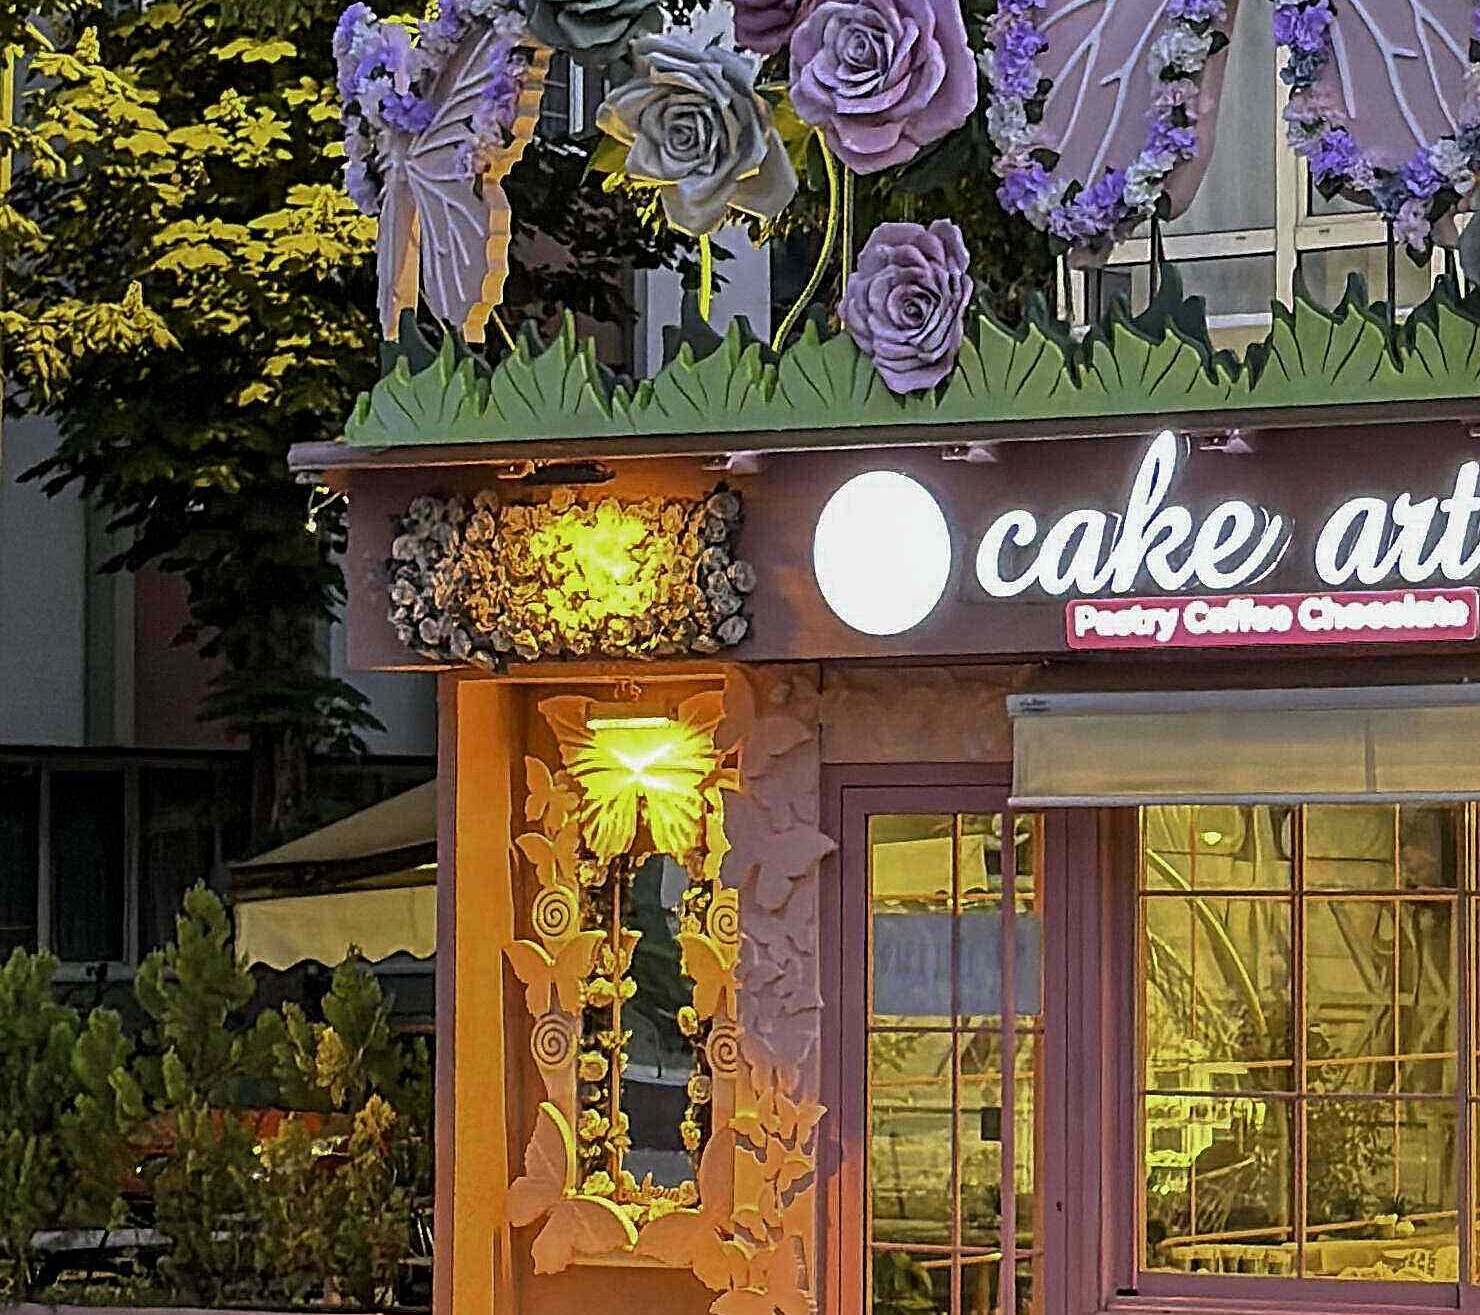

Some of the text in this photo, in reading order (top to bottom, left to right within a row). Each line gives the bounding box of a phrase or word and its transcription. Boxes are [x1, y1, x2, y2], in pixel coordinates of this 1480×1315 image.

[976, 430, 1283, 597] cake
[1074, 593, 1470, 643] Pastry Coffee Chocolate
